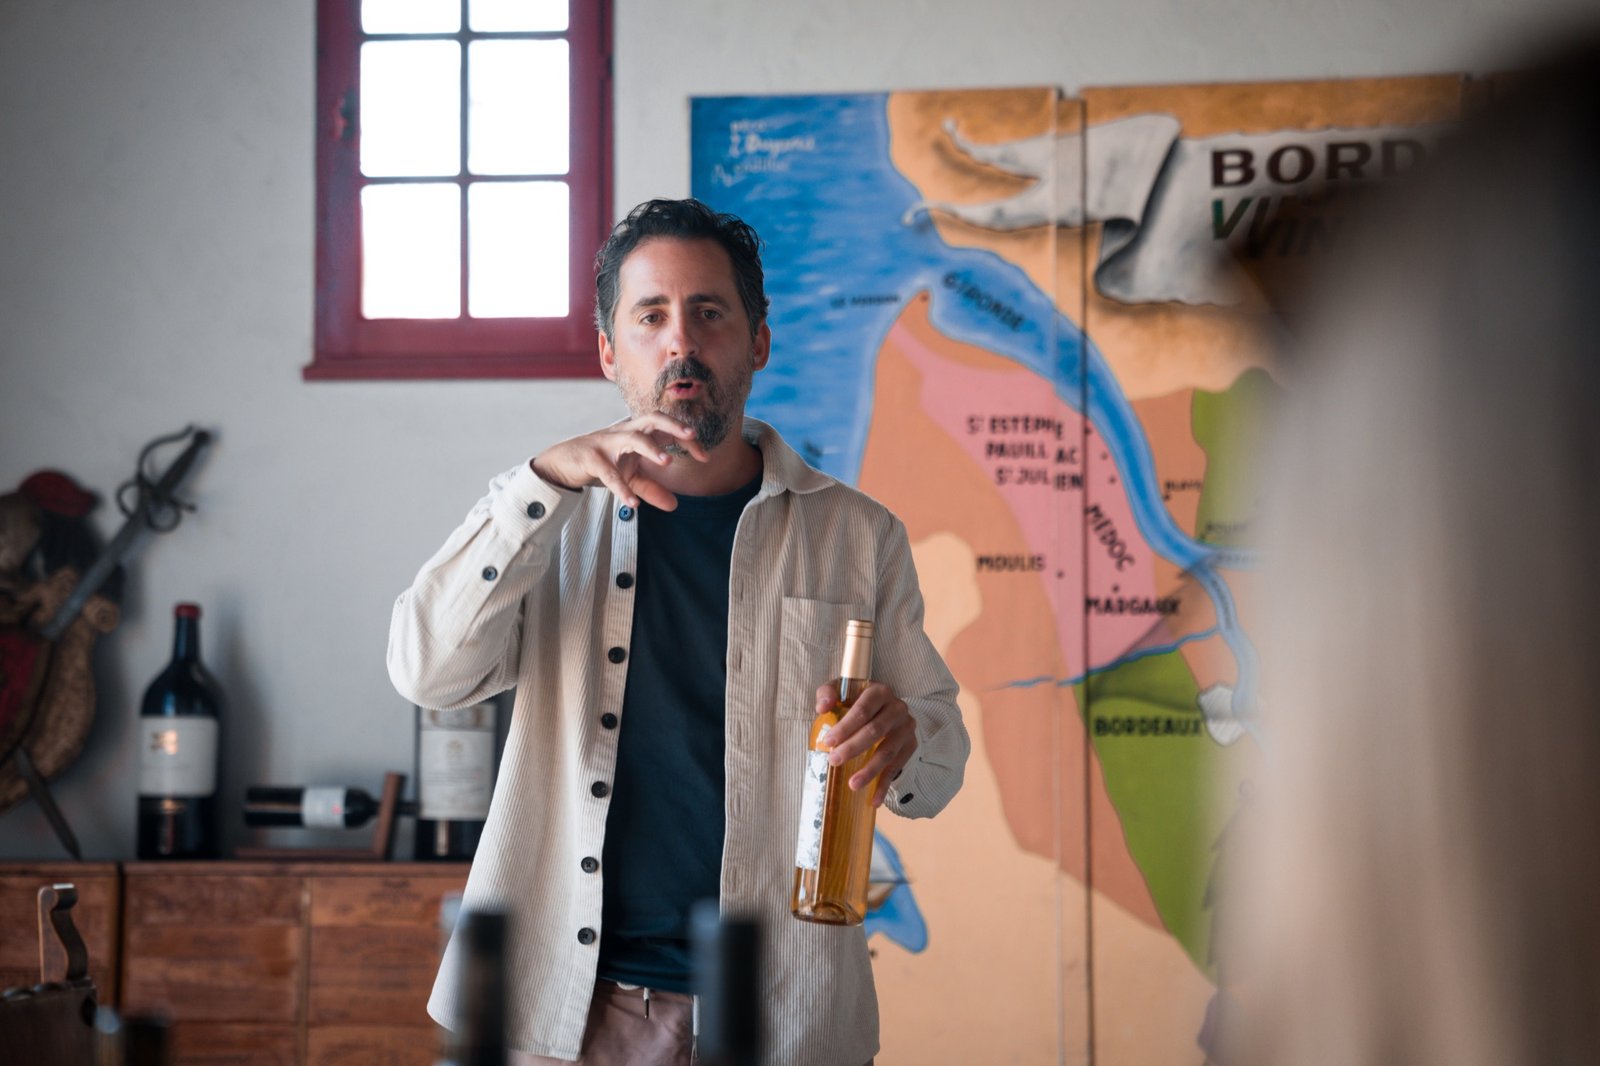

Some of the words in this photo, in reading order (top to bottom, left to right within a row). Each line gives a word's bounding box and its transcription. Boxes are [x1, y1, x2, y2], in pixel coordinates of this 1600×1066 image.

[943, 271, 1025, 331] GIRONDE
[977, 554, 1046, 572] MOULIS
[1086, 597, 1181, 616] MARGAUX
[1095, 715, 1203, 737] BORDEAUX
